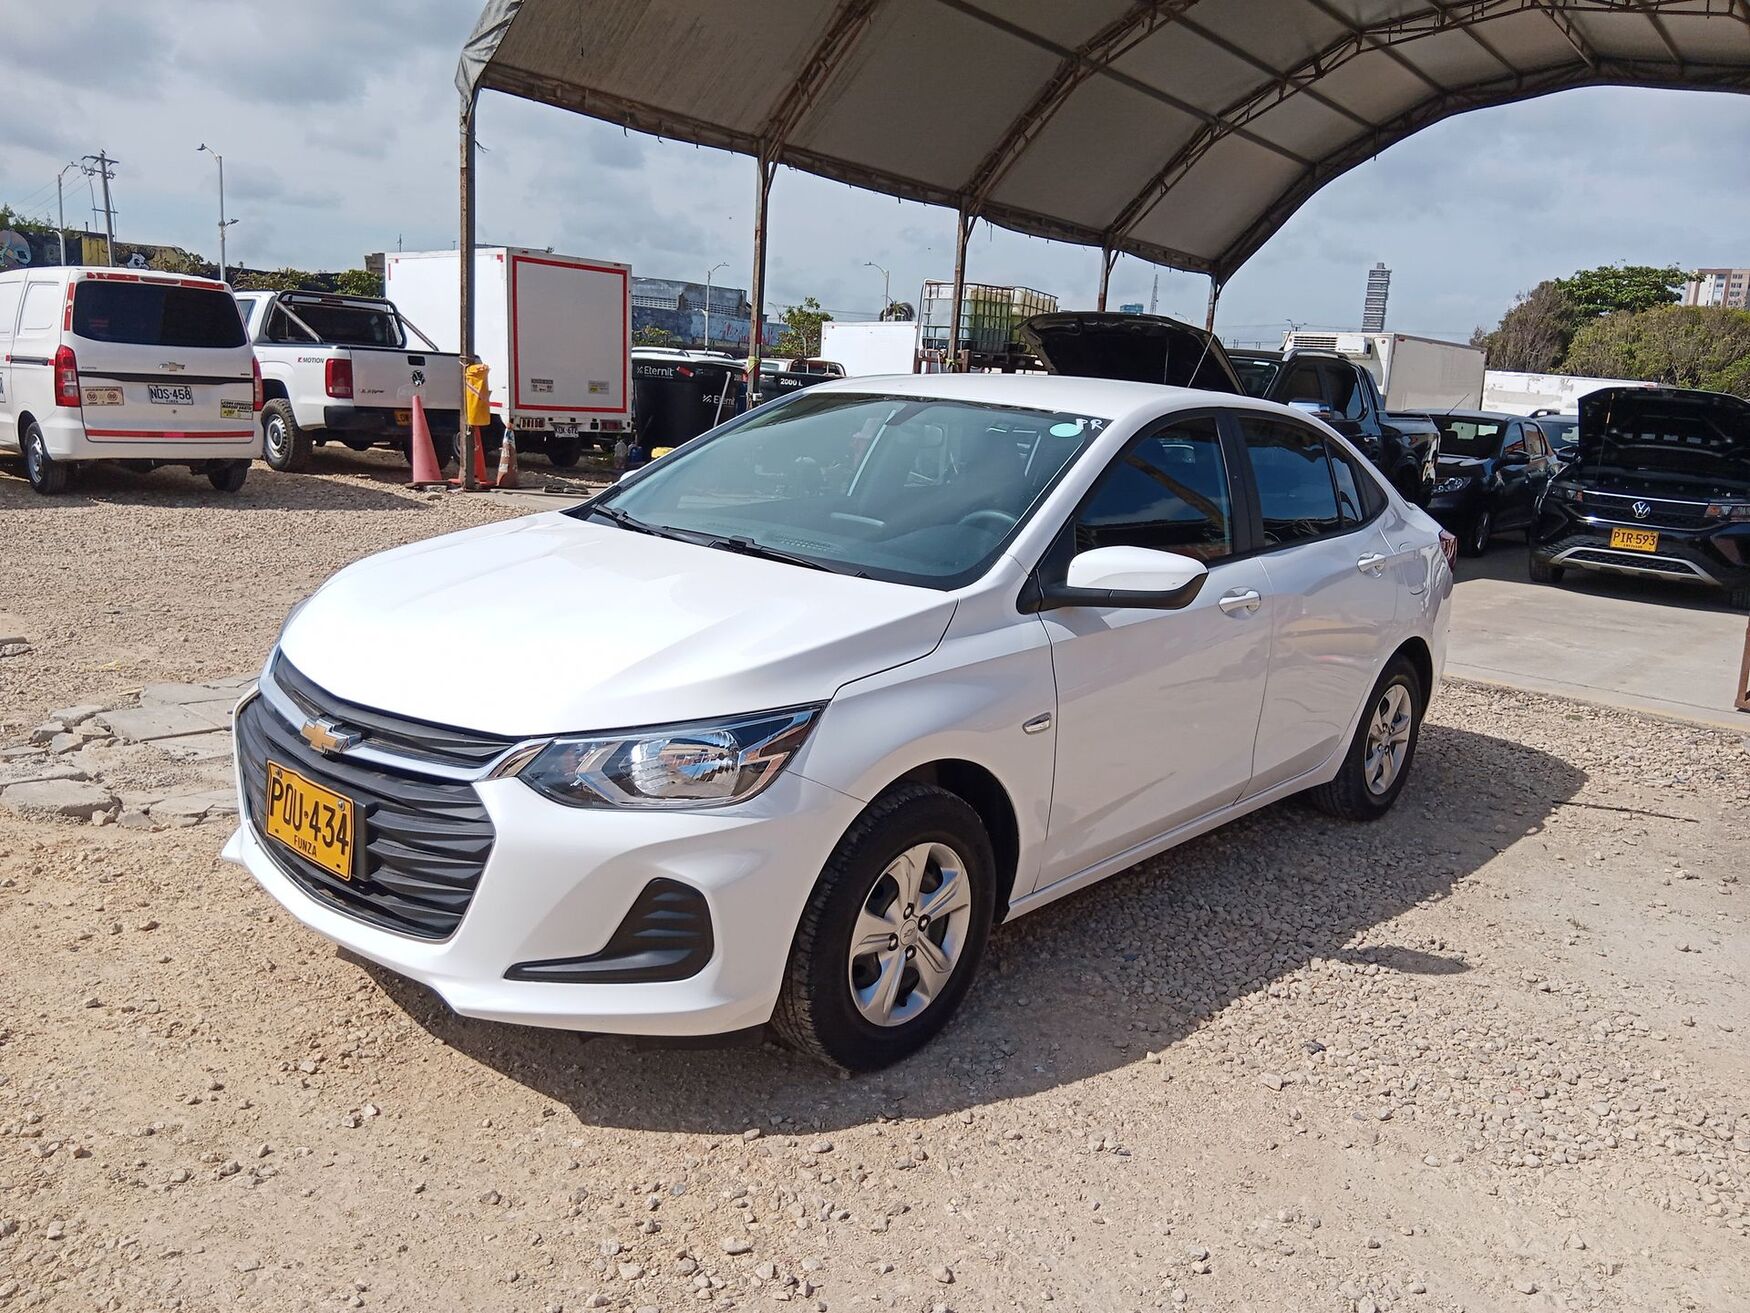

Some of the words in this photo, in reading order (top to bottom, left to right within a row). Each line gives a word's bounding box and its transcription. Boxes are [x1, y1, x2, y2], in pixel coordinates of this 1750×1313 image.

[644, 365, 675, 377] Eternit
[780, 377, 798, 386] 2000
[293, 834, 317, 857] FUNZA
